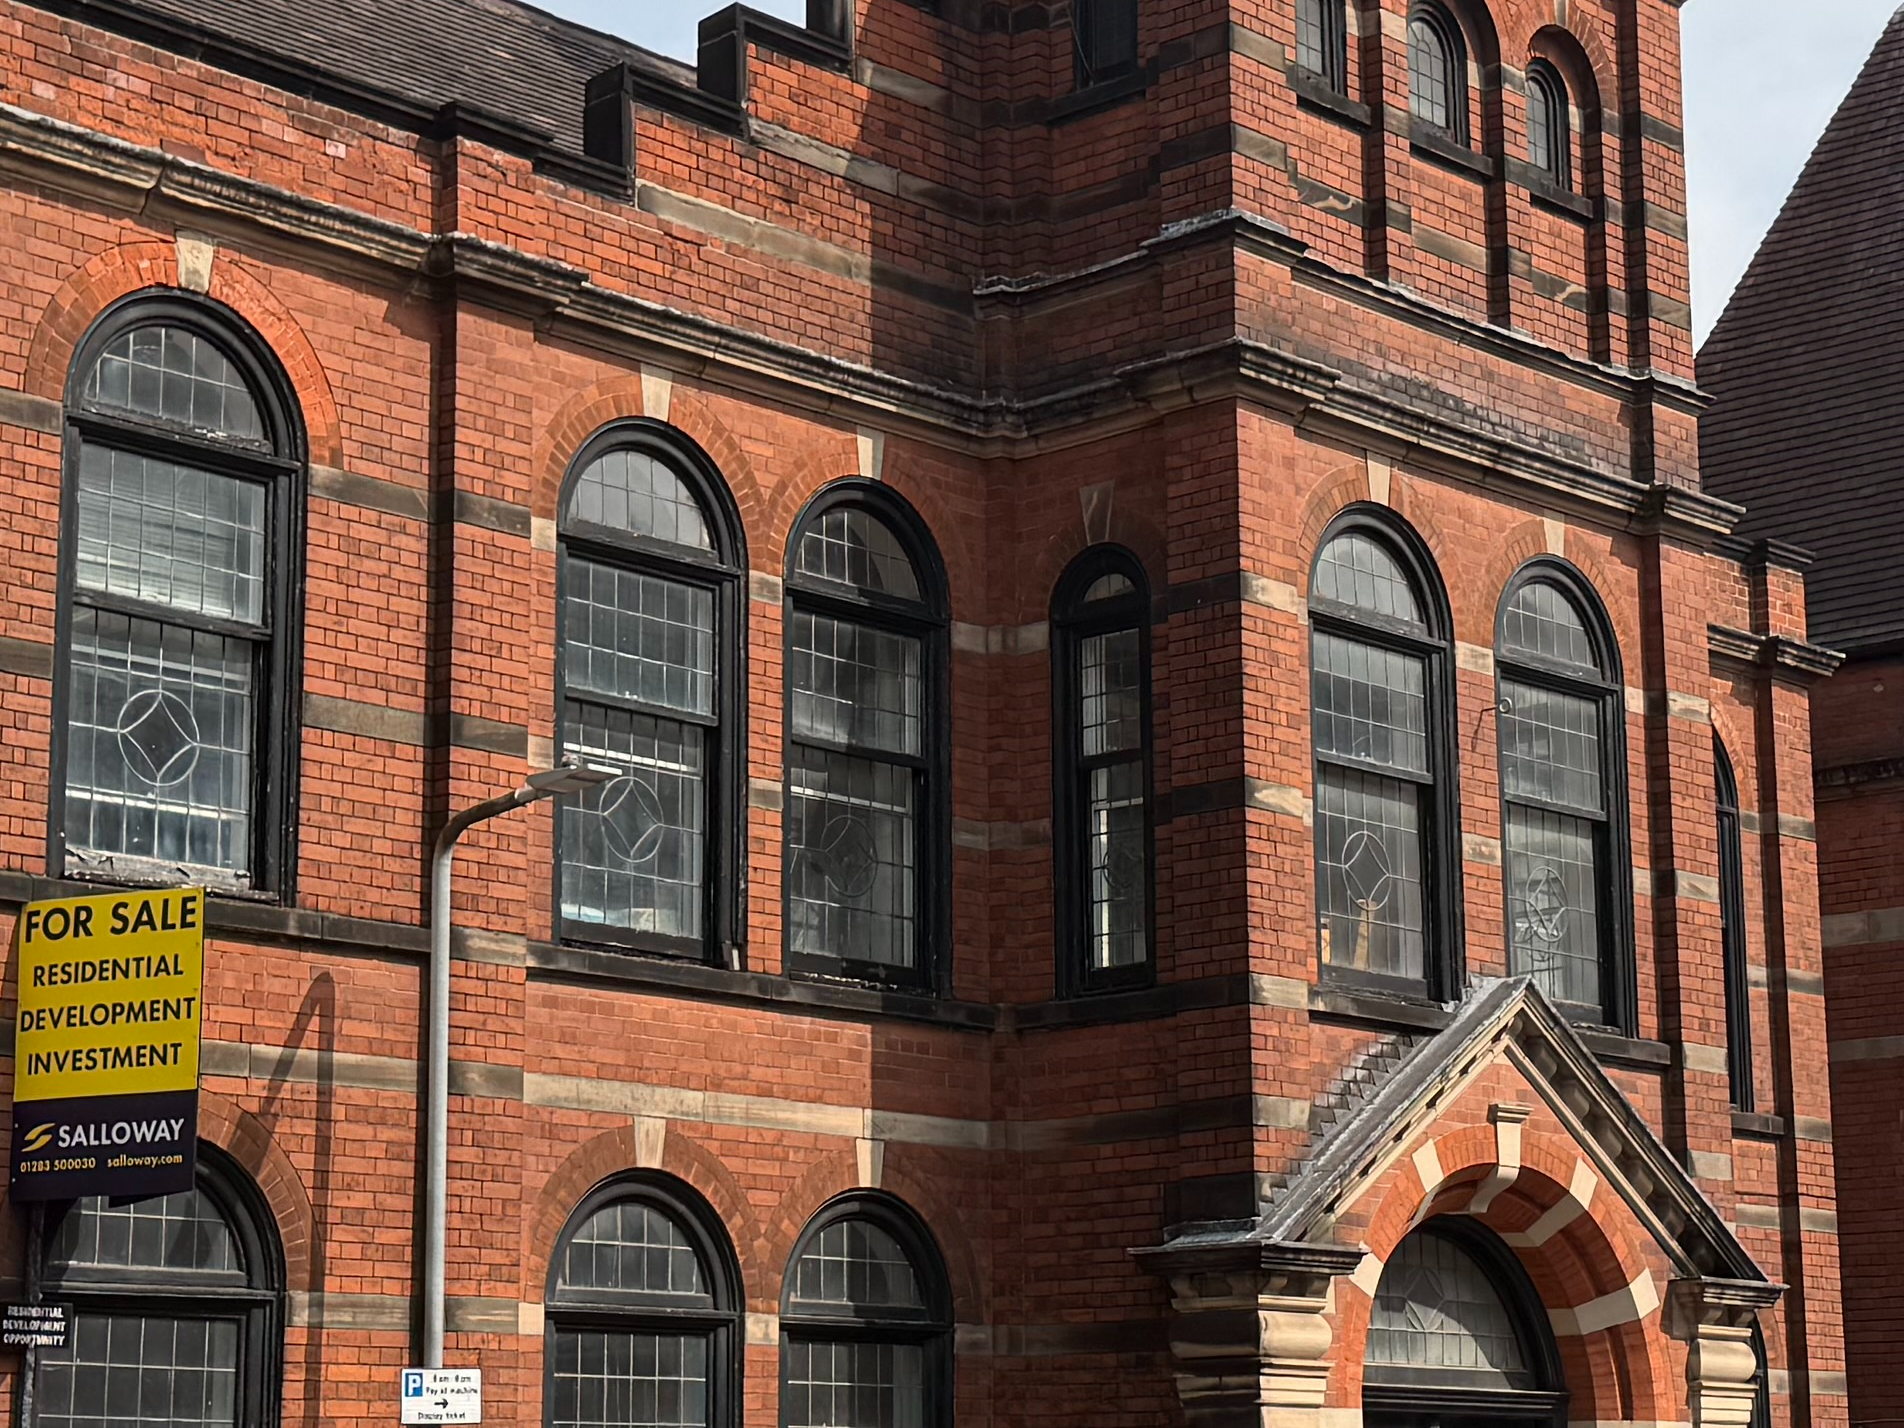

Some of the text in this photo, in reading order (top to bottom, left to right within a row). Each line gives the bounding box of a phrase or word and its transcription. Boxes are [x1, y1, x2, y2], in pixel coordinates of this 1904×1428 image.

[25, 895, 197, 943] FOR SALE
[33, 953, 184, 987] RESIDENTIAL
[20, 996, 196, 1033] DEVELOPMENT
[27, 1042, 183, 1075] INVESTMENT
[57, 1117, 185, 1149] SALLOWAY
[20, 1153, 183, 1173] 01283 500030 salloway.com
[2, 1319, 66, 1332] DEVELOPMENT
[7, 1305, 64, 1318] RESIDENTIAL
[3, 1333, 65, 1346] OPPORTUNITY
